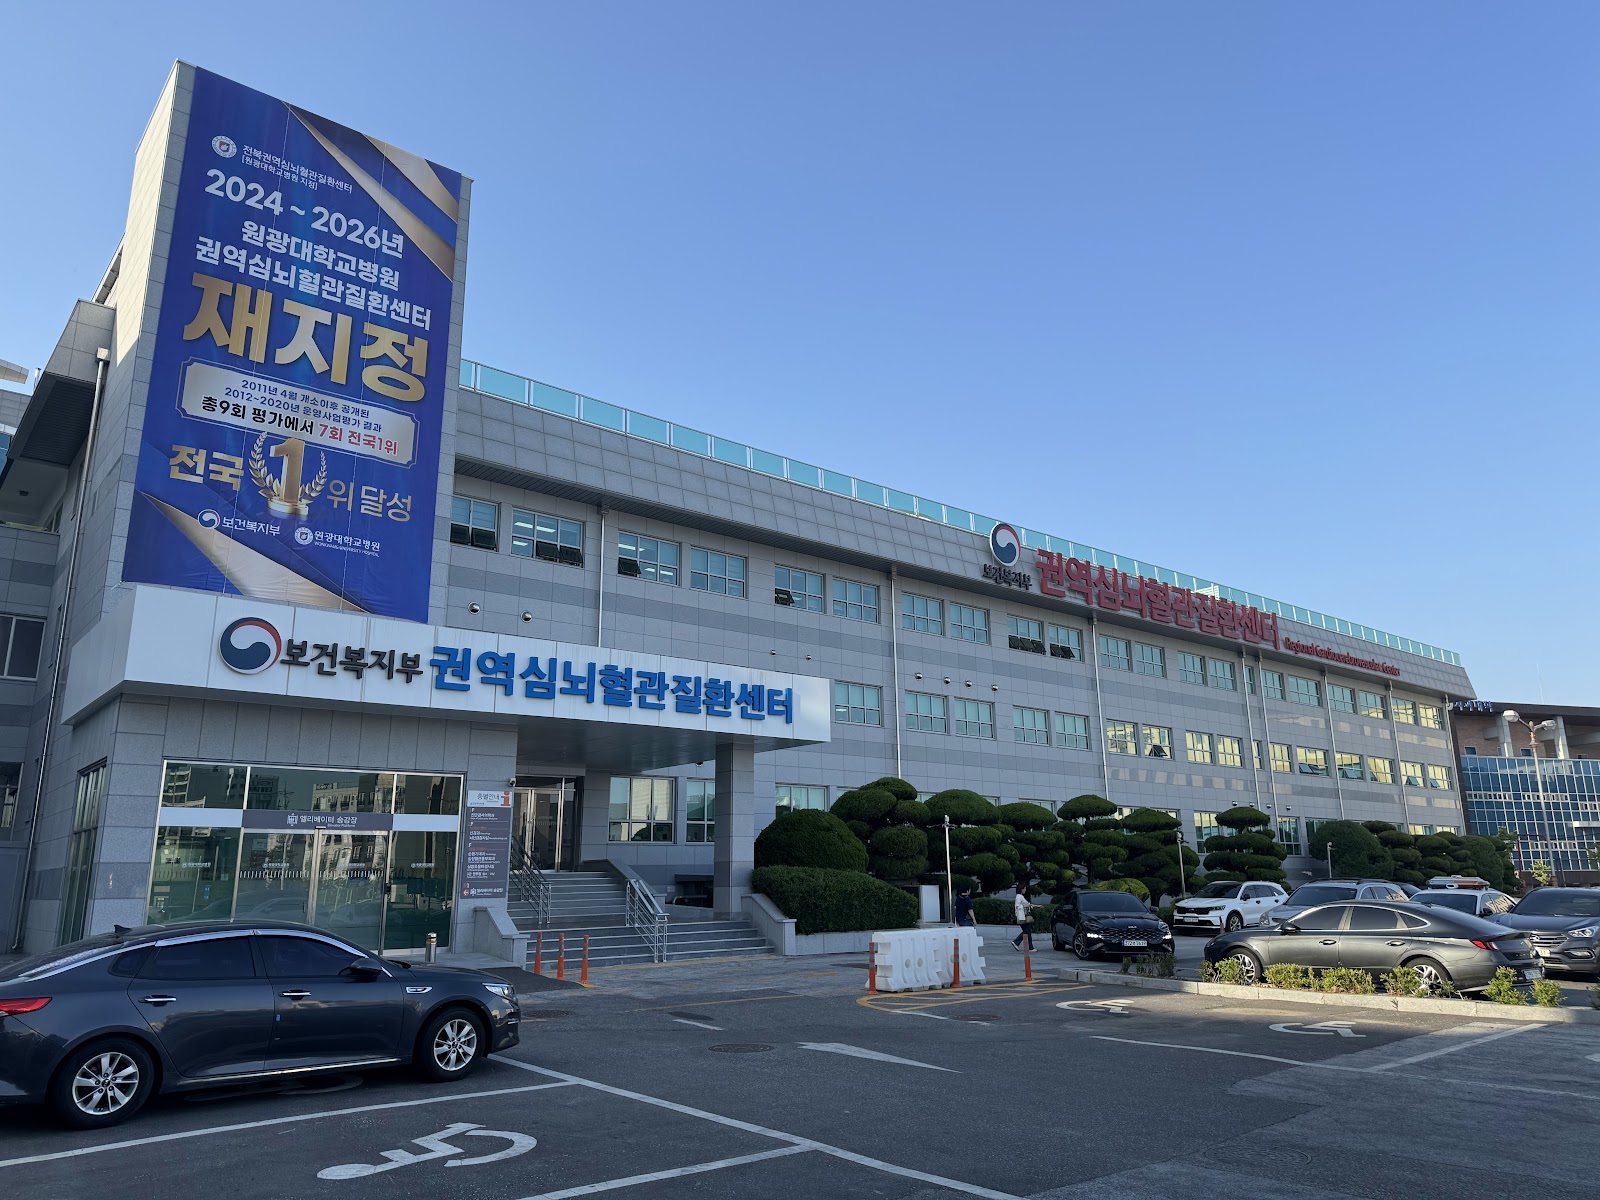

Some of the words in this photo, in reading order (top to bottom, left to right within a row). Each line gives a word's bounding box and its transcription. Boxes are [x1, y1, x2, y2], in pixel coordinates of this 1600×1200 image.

[242, 144, 353, 194] 전북권역심뇌혈관질환센터
[204, 168, 283, 216] 2024
[311, 206, 404, 259] 2026년
[241, 220, 400, 291] 원광대학교병원
[195, 236, 431, 331] 권역심뇌혈관질환센터
[183, 272, 428, 402] 재지정
[201, 396, 246, 420] 총9회
[251, 407, 314, 435] 평가에서
[318, 423, 343, 442] 7회
[347, 429, 398, 455] 전국1위
[224, 387, 300, 413] 2012~2020년
[303, 406, 361, 428] 운영사업평가
[363, 420, 382, 433] 결과
[242, 379, 278, 397] 2011년
[280, 389, 298, 401] 4월
[300, 394, 339, 411] 개소이후
[341, 403, 369, 419] 공개된
[168, 444, 245, 491] 전국
[269, 437, 306, 504] 1
[327, 478, 353, 511] 위
[360, 486, 412, 522] 달성
[222, 516, 281, 536] 보건복지부
[314, 530, 380, 552] 원광대학교병원
[980, 563, 1033, 590] 보건복지부
[1035, 548, 1280, 650] 권역심뇌혈관질환센터
[1285, 637, 1314, 655] Regional
[280, 638, 423, 684] 보건복지부
[430, 645, 793, 724] 권역심뇌혈관질환센터
[300, 815, 335, 824] 엘리베이터
[336, 816, 357, 824] 승강장
